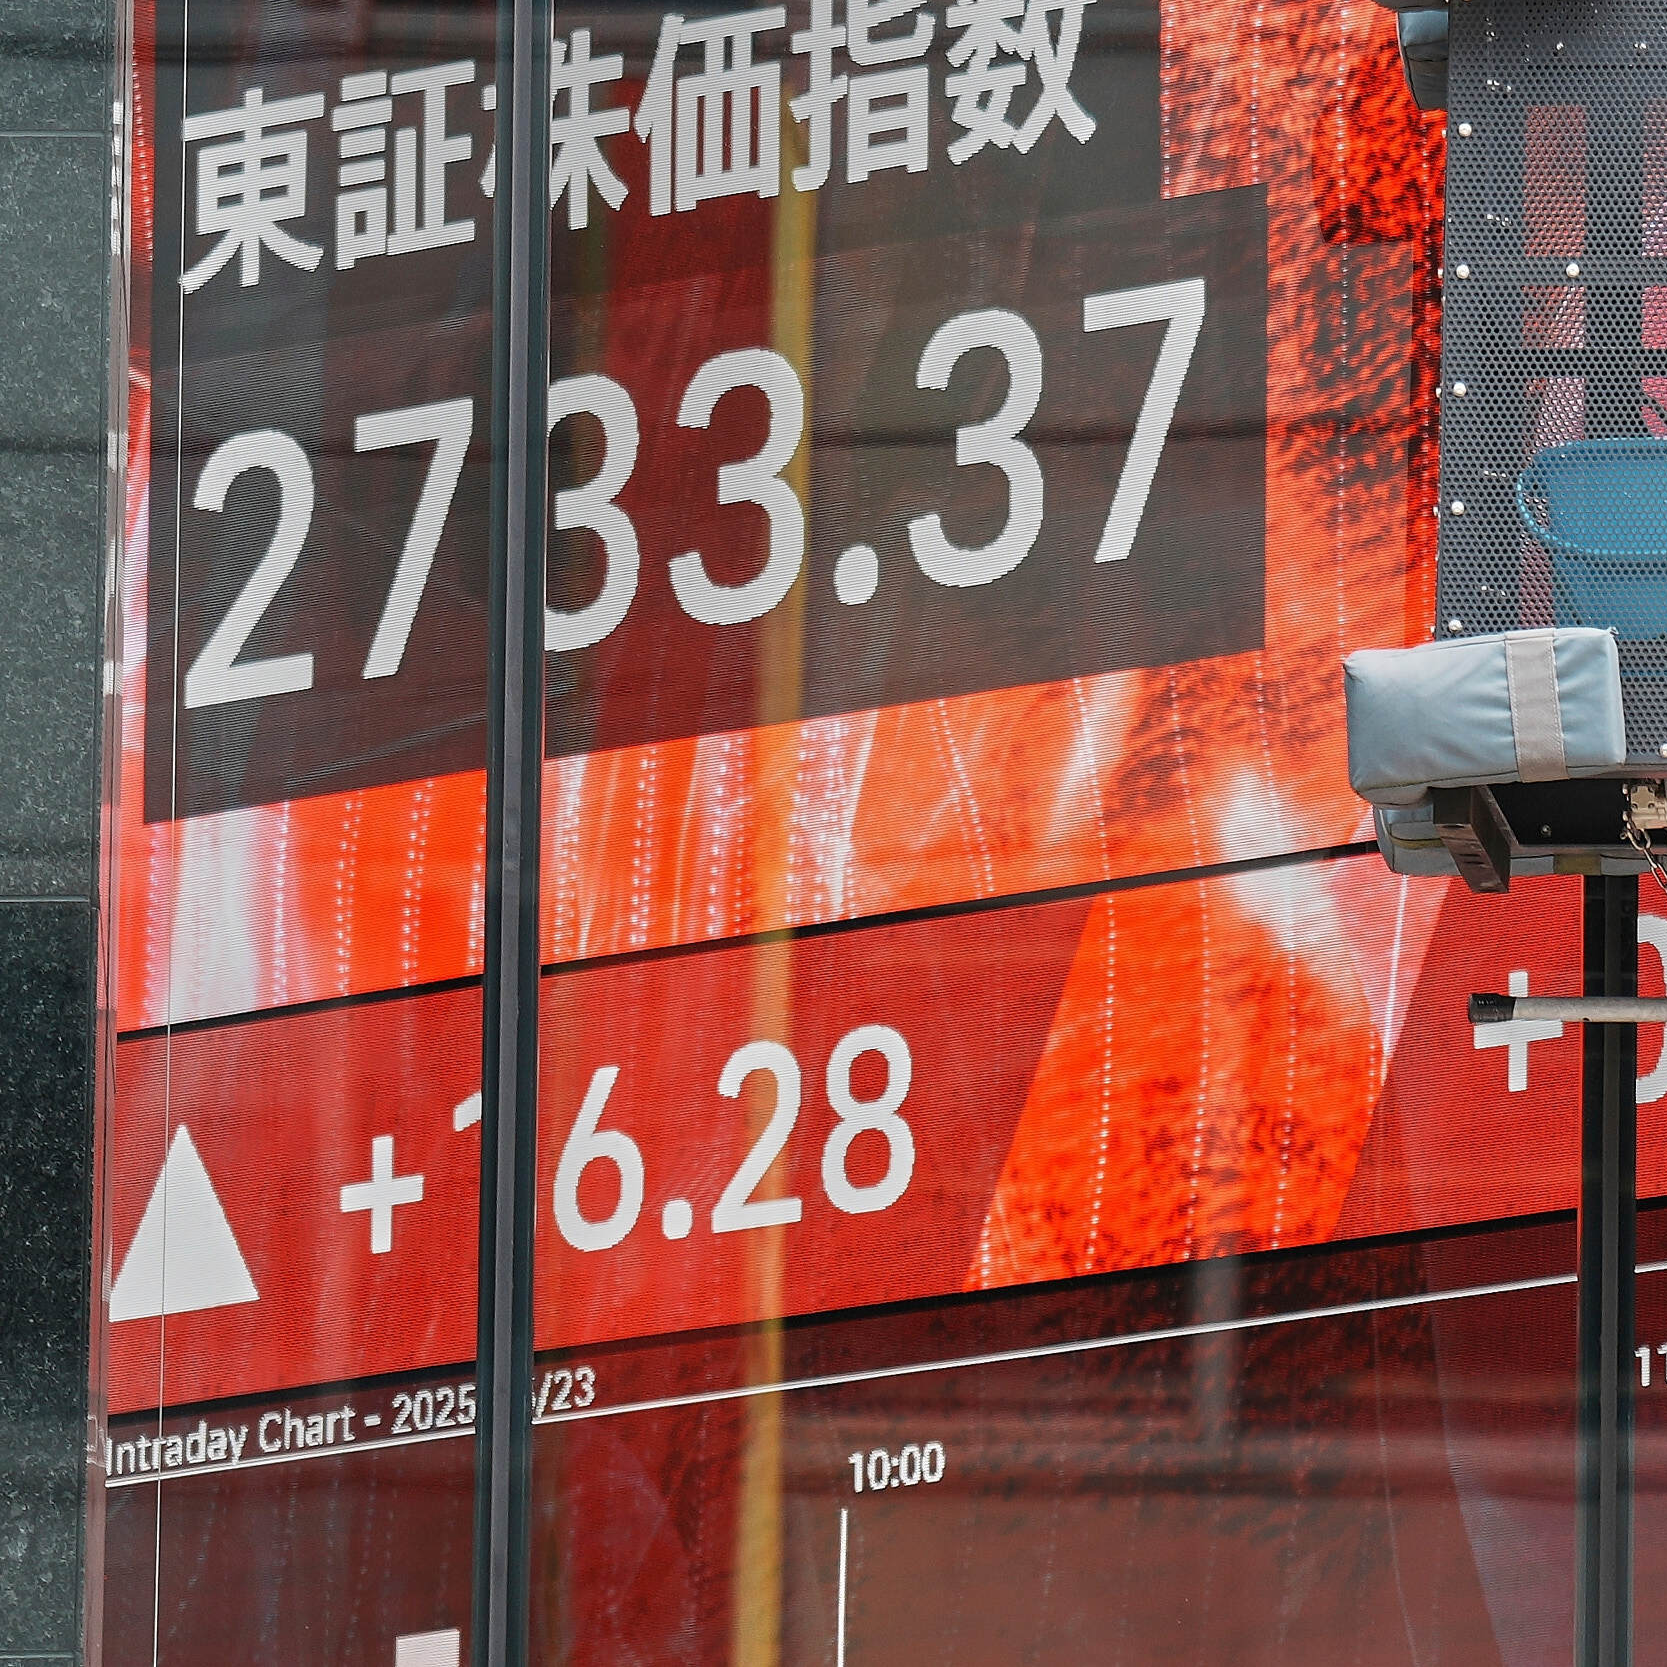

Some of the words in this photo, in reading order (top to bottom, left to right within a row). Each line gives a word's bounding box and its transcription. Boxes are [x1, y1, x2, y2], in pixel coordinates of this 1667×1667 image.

[183, 277, 1206, 709] 2733.37
[339, 1023, 916, 1254] +6.28
[105, 1419, 249, 1476] Intraday
[258, 1406, 357, 1455] Chart
[390, 1364, 597, 1434] 2025/23
[848, 1442, 946, 1494] 10:00
